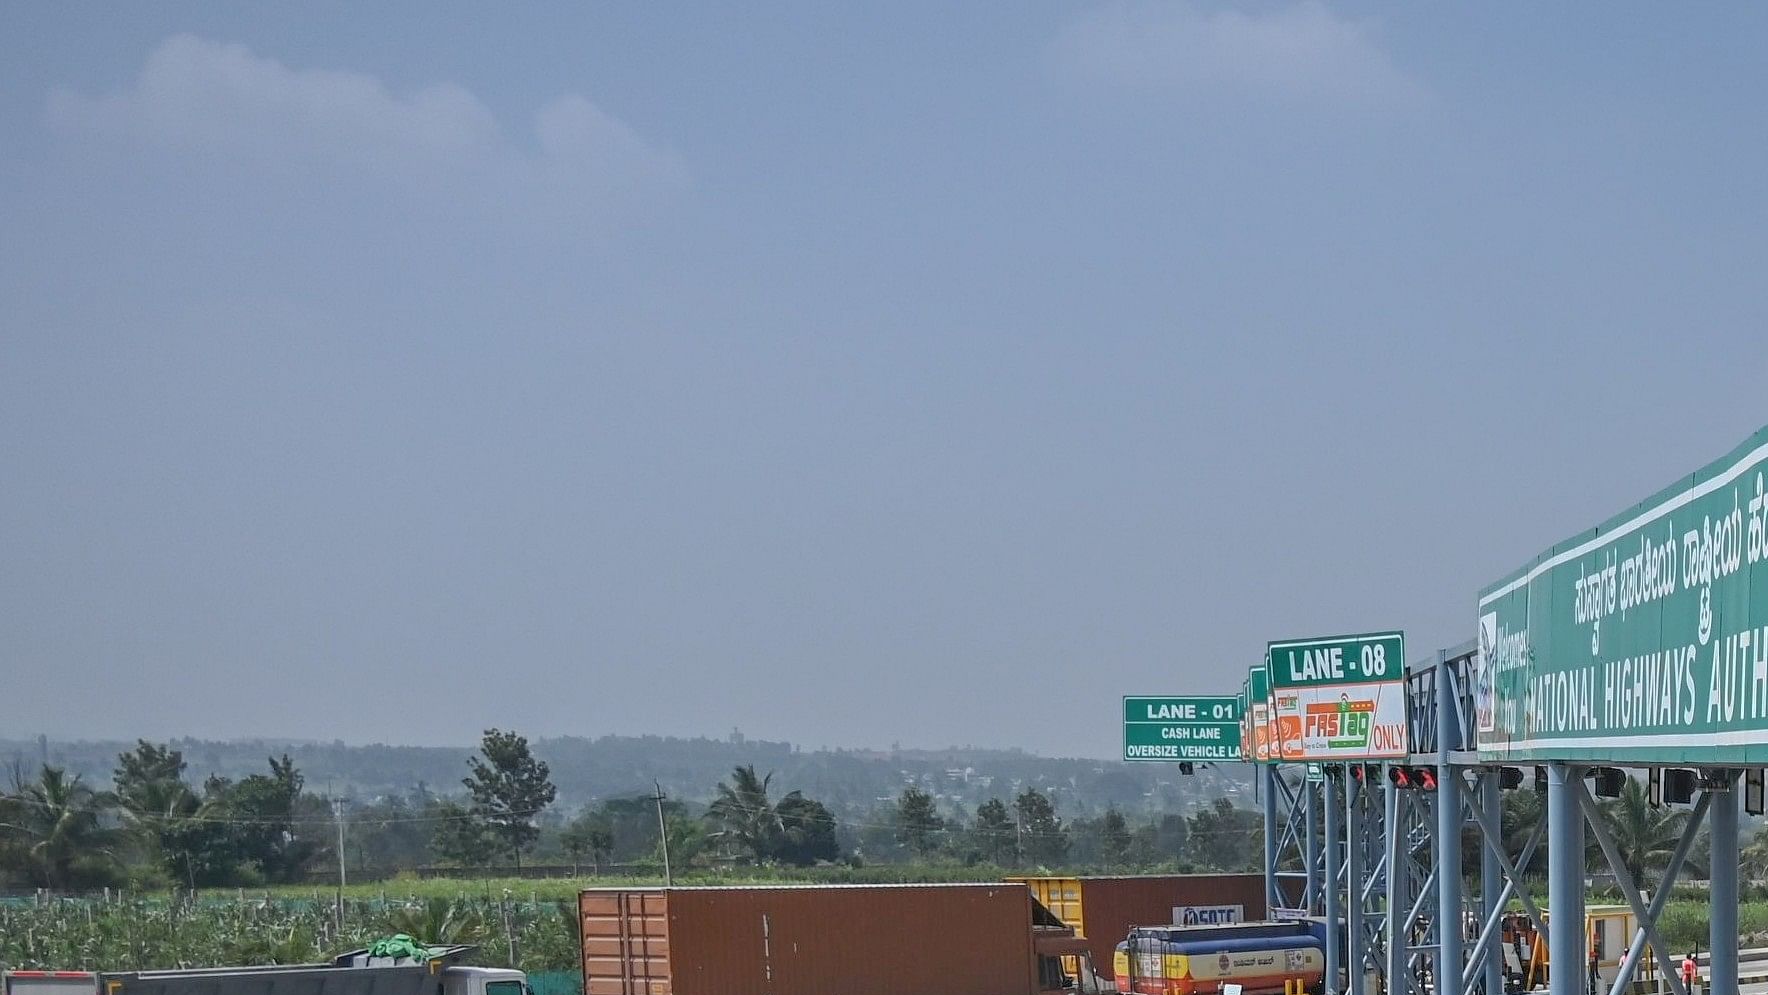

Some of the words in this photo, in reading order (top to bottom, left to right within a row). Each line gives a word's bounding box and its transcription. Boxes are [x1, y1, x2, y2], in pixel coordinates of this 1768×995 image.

[1620, 519, 1677, 623] ಭಾರತೀಯ
[1289, 647, 1344, 682] LANE
[1361, 644, 1386, 677] 08
[1530, 666, 1597, 734] NATIONAL
[1604, 643, 1697, 730] HIGHWAYS
[1147, 704, 1196, 719] LANE
[1212, 704, 1233, 719] 01
[1161, 727, 1190, 739] CASH
[1193, 727, 1221, 739] LANE
[1373, 723, 1405, 751] ONLY
[1127, 745, 1178, 757] OVERSIZE
[1180, 745, 1225, 758] VEHICLE
[1228, 746, 1242, 758] LA
